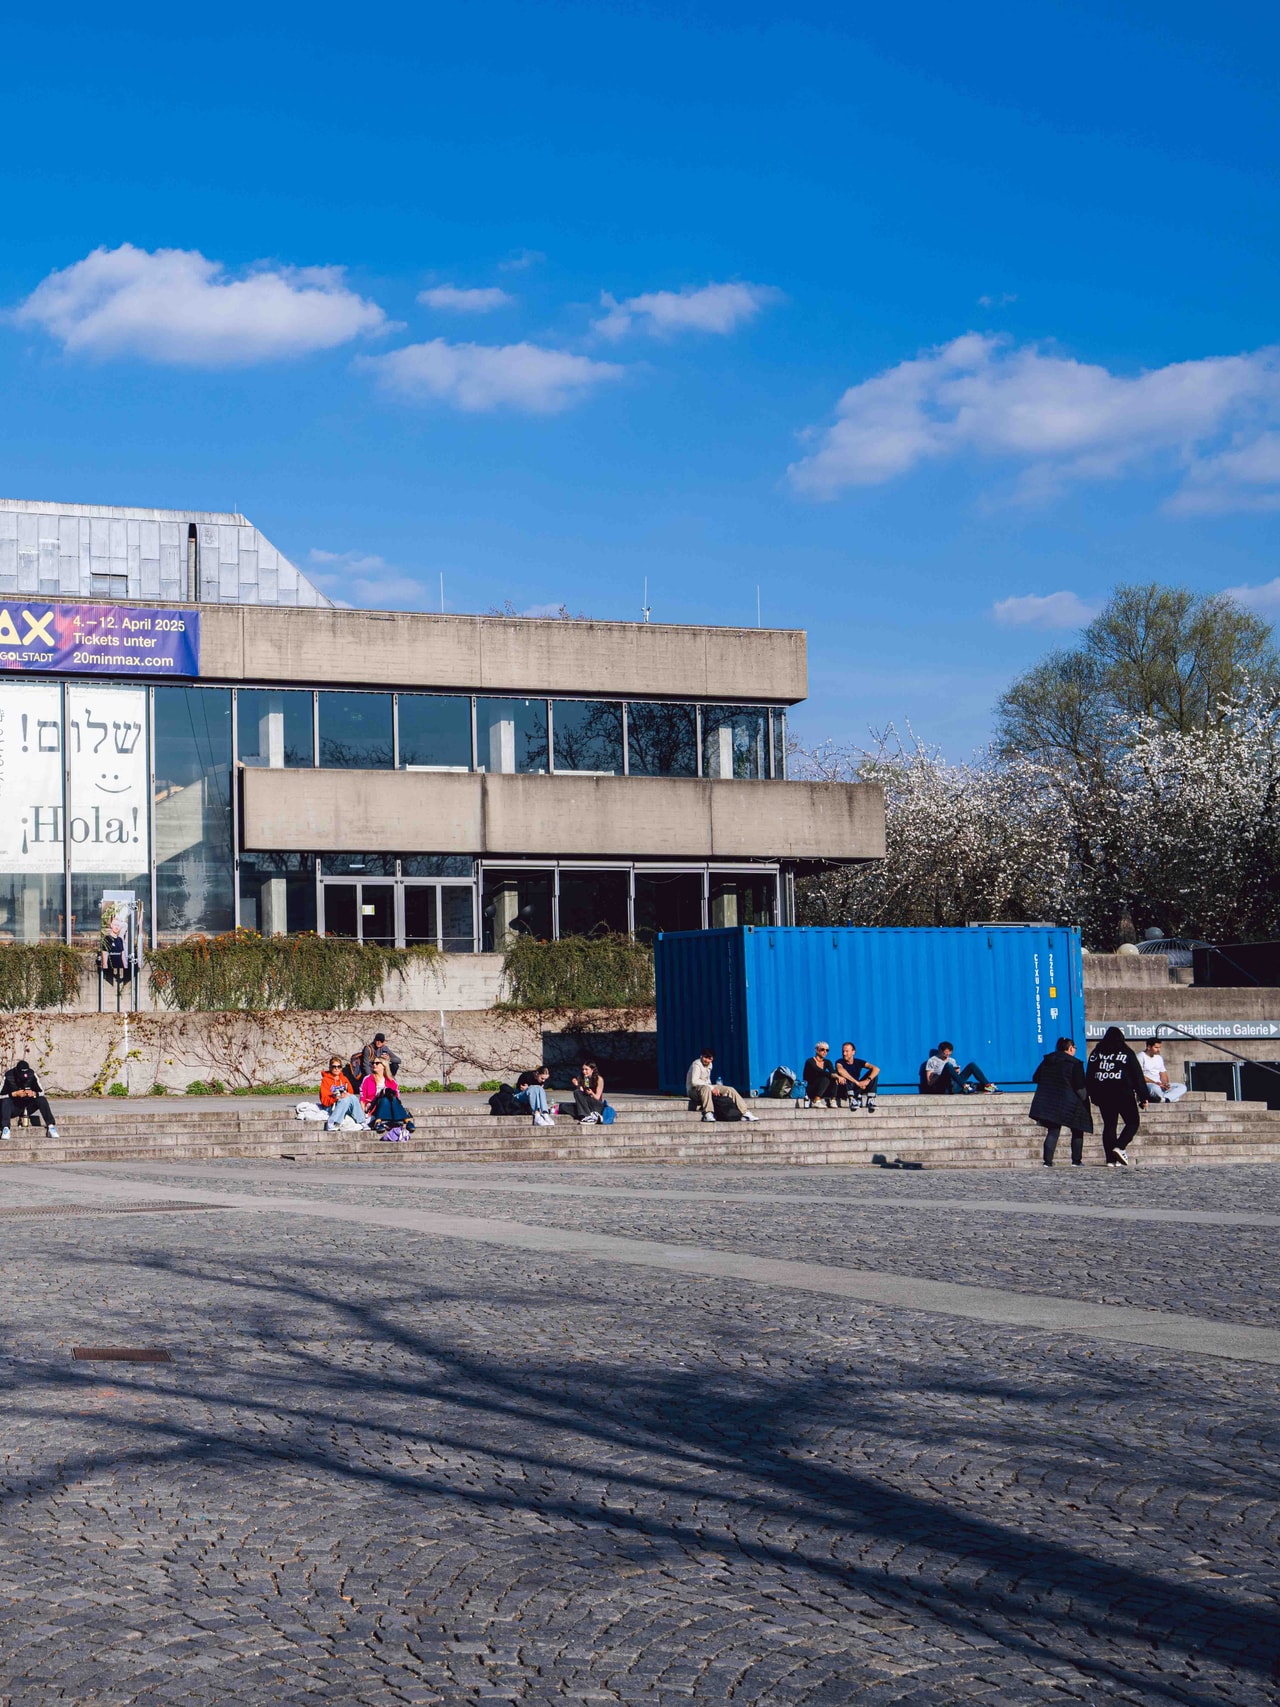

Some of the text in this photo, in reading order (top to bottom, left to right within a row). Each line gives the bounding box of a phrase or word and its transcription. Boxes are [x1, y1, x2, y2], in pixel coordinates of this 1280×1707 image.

[121, 617, 152, 632] April
[154, 619, 186, 632] 2025
[73, 632, 157, 648] Tickets unter
[73, 651, 174, 667] 20minmax.com
[21, 707, 142, 754] שלום!
[21, 805, 139, 855] ¡Hola!
[1086, 1024, 1269, 1036] Juns Theater Städtische Galerie
[1115, 1051, 1128, 1064] in
[1099, 1060, 1116, 1072] the
[1094, 1069, 1123, 1082] mood
